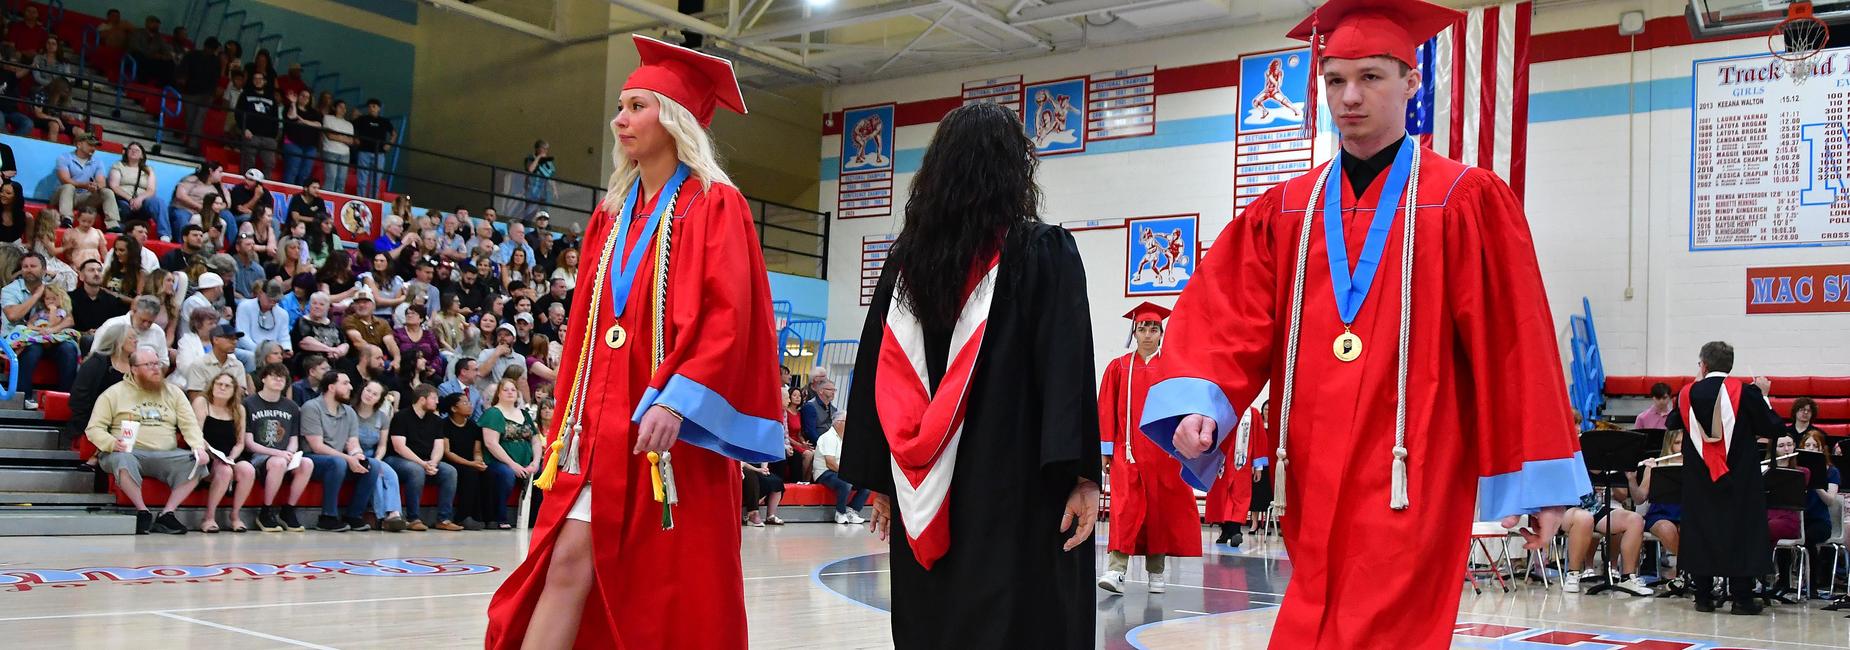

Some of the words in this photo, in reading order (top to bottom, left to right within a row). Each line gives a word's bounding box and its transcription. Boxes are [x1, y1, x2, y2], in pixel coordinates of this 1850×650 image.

[1718, 58, 1784, 86] Track
[1732, 86, 1765, 97] GIRLS
[1751, 275, 1814, 304] MAC
[252, 409, 292, 421] MURPHY
